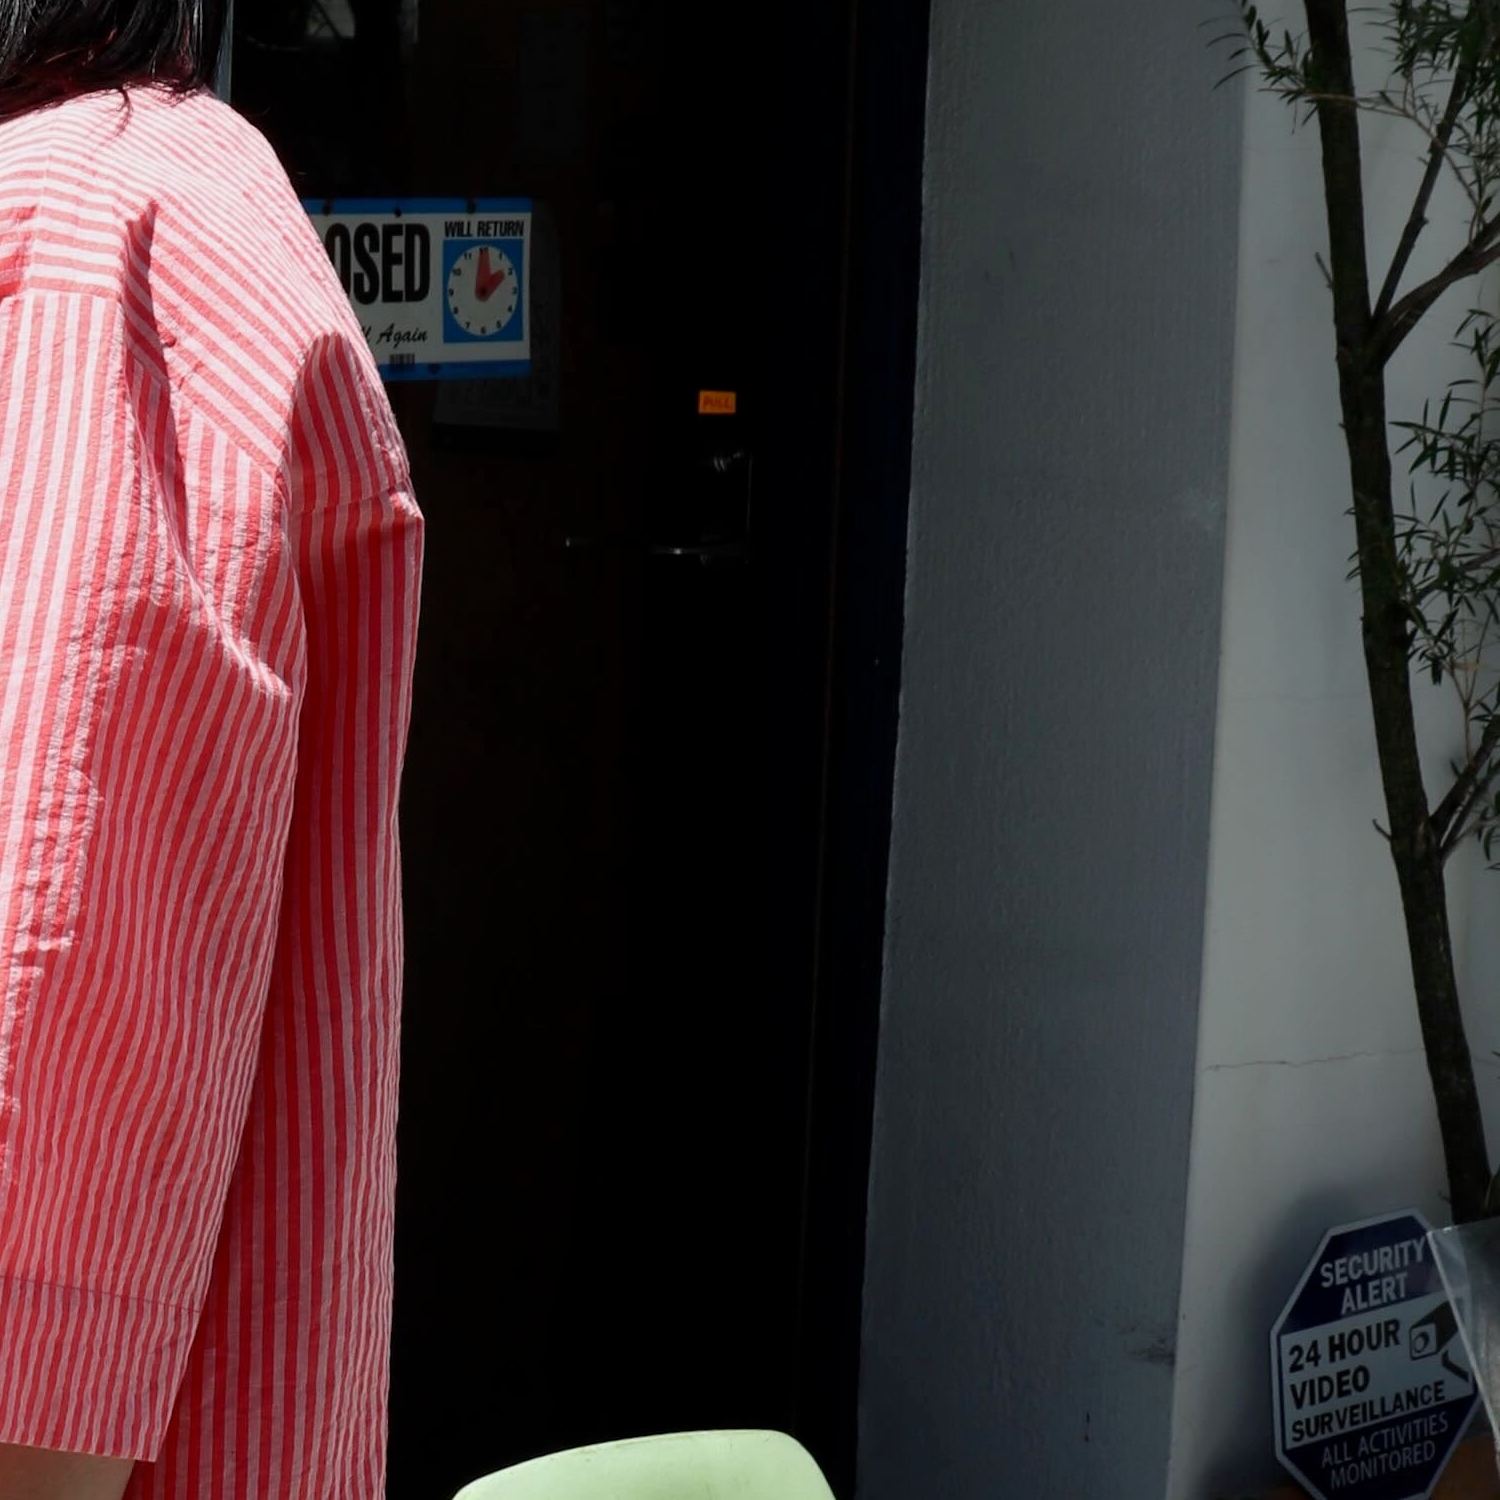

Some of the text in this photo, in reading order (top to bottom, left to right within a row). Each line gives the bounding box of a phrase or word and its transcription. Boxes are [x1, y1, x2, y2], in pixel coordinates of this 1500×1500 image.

[444, 220, 524, 237] WILL RETURN
[324, 222, 430, 305] OSED
[376, 322, 428, 349] Again
[1320, 1236, 1427, 1288] SECURITY
[1340, 1271, 1409, 1315] ALERT
[1288, 1318, 1402, 1374] 24 HOUR
[1289, 1364, 1371, 1410] VIDEO
[1291, 1379, 1446, 1443] SURVEILLANCE
[1321, 1411, 1449, 1468] ALL ACTIVITIES
[1330, 1440, 1436, 1490] MONITORED
